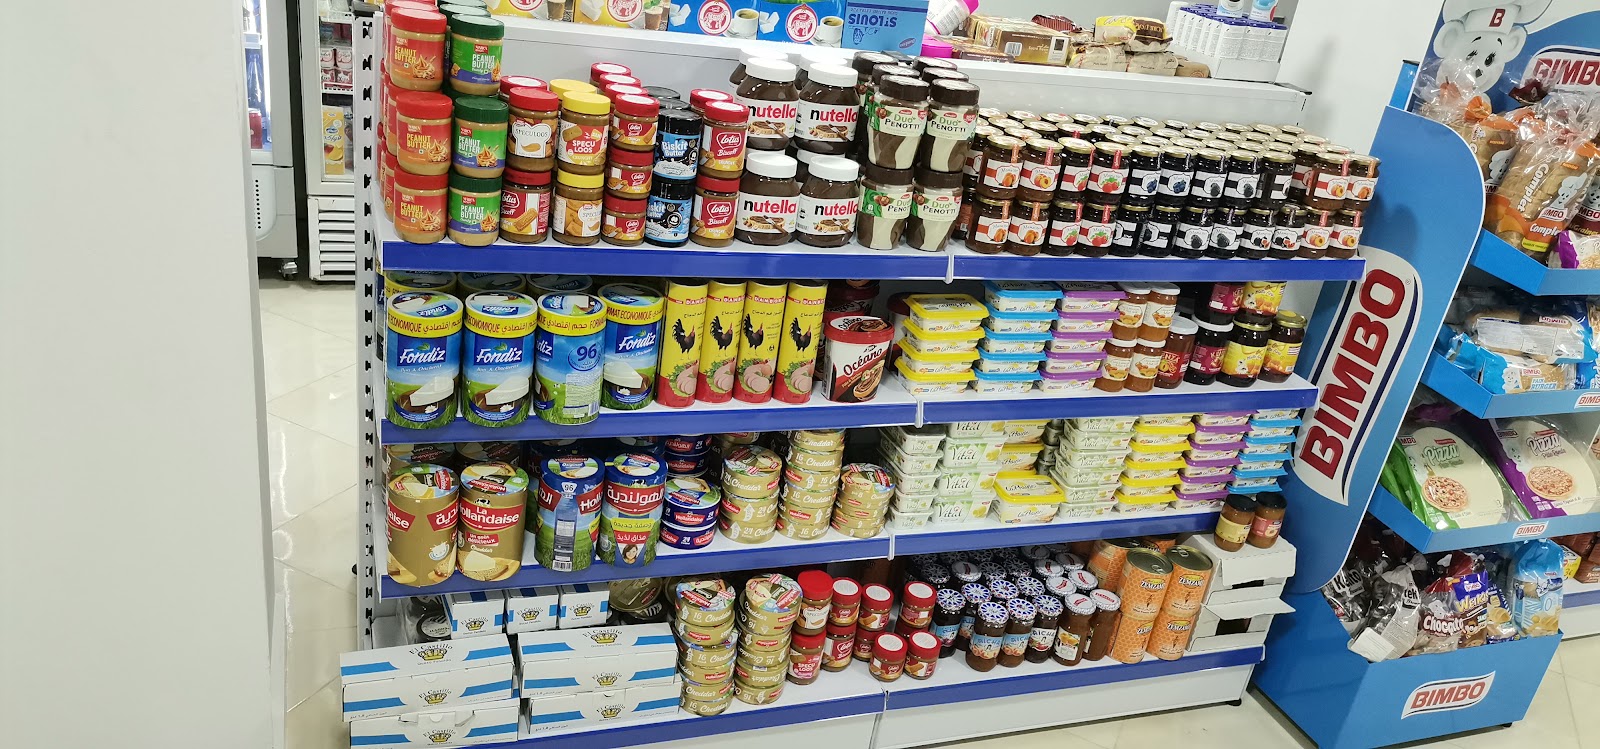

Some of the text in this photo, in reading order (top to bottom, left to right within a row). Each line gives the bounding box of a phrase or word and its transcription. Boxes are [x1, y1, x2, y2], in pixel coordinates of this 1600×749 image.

[1489, 8, 1505, 28] B
[394, 45, 416, 57] PEANUT
[394, 53, 416, 64] BUTTER
[472, 54, 496, 64] PEANUT
[472, 60, 495, 70] BUTTER
[1533, 58, 1600, 86] BIMB
[748, 104, 796, 119] nutella
[810, 105, 858, 123] nutella
[931, 121, 966, 132] PENOTTI
[406, 133, 431, 144] PEANUT
[458, 136, 480, 147] PEANUT
[572, 140, 596, 148] SPECU
[720, 134, 740, 144] Lotus
[406, 140, 431, 150] BUTTER
[458, 142, 480, 154] BUTTER
[662, 140, 688, 150] Biskit
[717, 148, 738, 157] Biscoff
[1517, 163, 1550, 212] Complet
[400, 202, 424, 211] PEANUT
[460, 204, 484, 214] PEANUT
[648, 203, 666, 212] iskit
[711, 204, 730, 214] Lotus
[743, 200, 796, 214] nutella
[814, 200, 858, 216] nutella
[400, 210, 423, 219] BUTTER
[460, 212, 484, 220] BUTTER
[708, 217, 728, 226] Biscoff
[620, 309, 652, 321] ECONOMIQUE
[618, 332, 656, 350] Fondiz
[400, 348, 446, 363] Fondiz
[476, 348, 522, 364] Fondiz
[577, 344, 597, 360] 96
[1161, 352, 1180, 362] ENZA
[843, 348, 883, 376] Océano
[1299, 268, 1406, 480] BIMBO
[794, 431, 802, 440] 16
[1526, 434, 1560, 455] Pizza
[796, 452, 836, 467] 16 Cheddar
[952, 446, 976, 461] Vital
[1424, 444, 1460, 466] Pizza
[732, 478, 762, 492] Cheddar
[820, 476, 828, 485] 16
[946, 476, 970, 490] Vital
[564, 484, 574, 492] 96
[792, 490, 832, 504] 16 Cheddar
[758, 506, 766, 515] 24
[938, 504, 962, 518] Vital
[675, 514, 704, 523] Hollandaise
[744, 526, 753, 534] 24
[801, 528, 808, 536] 16
[1516, 524, 1545, 536] BIMBO
[616, 534, 646, 542] مذاق لذيذ
[694, 610, 732, 622] 16 Cheddar
[744, 601, 768, 622] Cheddar
[1032, 629, 1055, 638] AICHA
[698, 650, 736, 663] 16 Cheddar
[686, 686, 716, 698] Cheddar
[1410, 680, 1486, 710] BIMBO
[689, 701, 728, 714] 16 Cheddar
